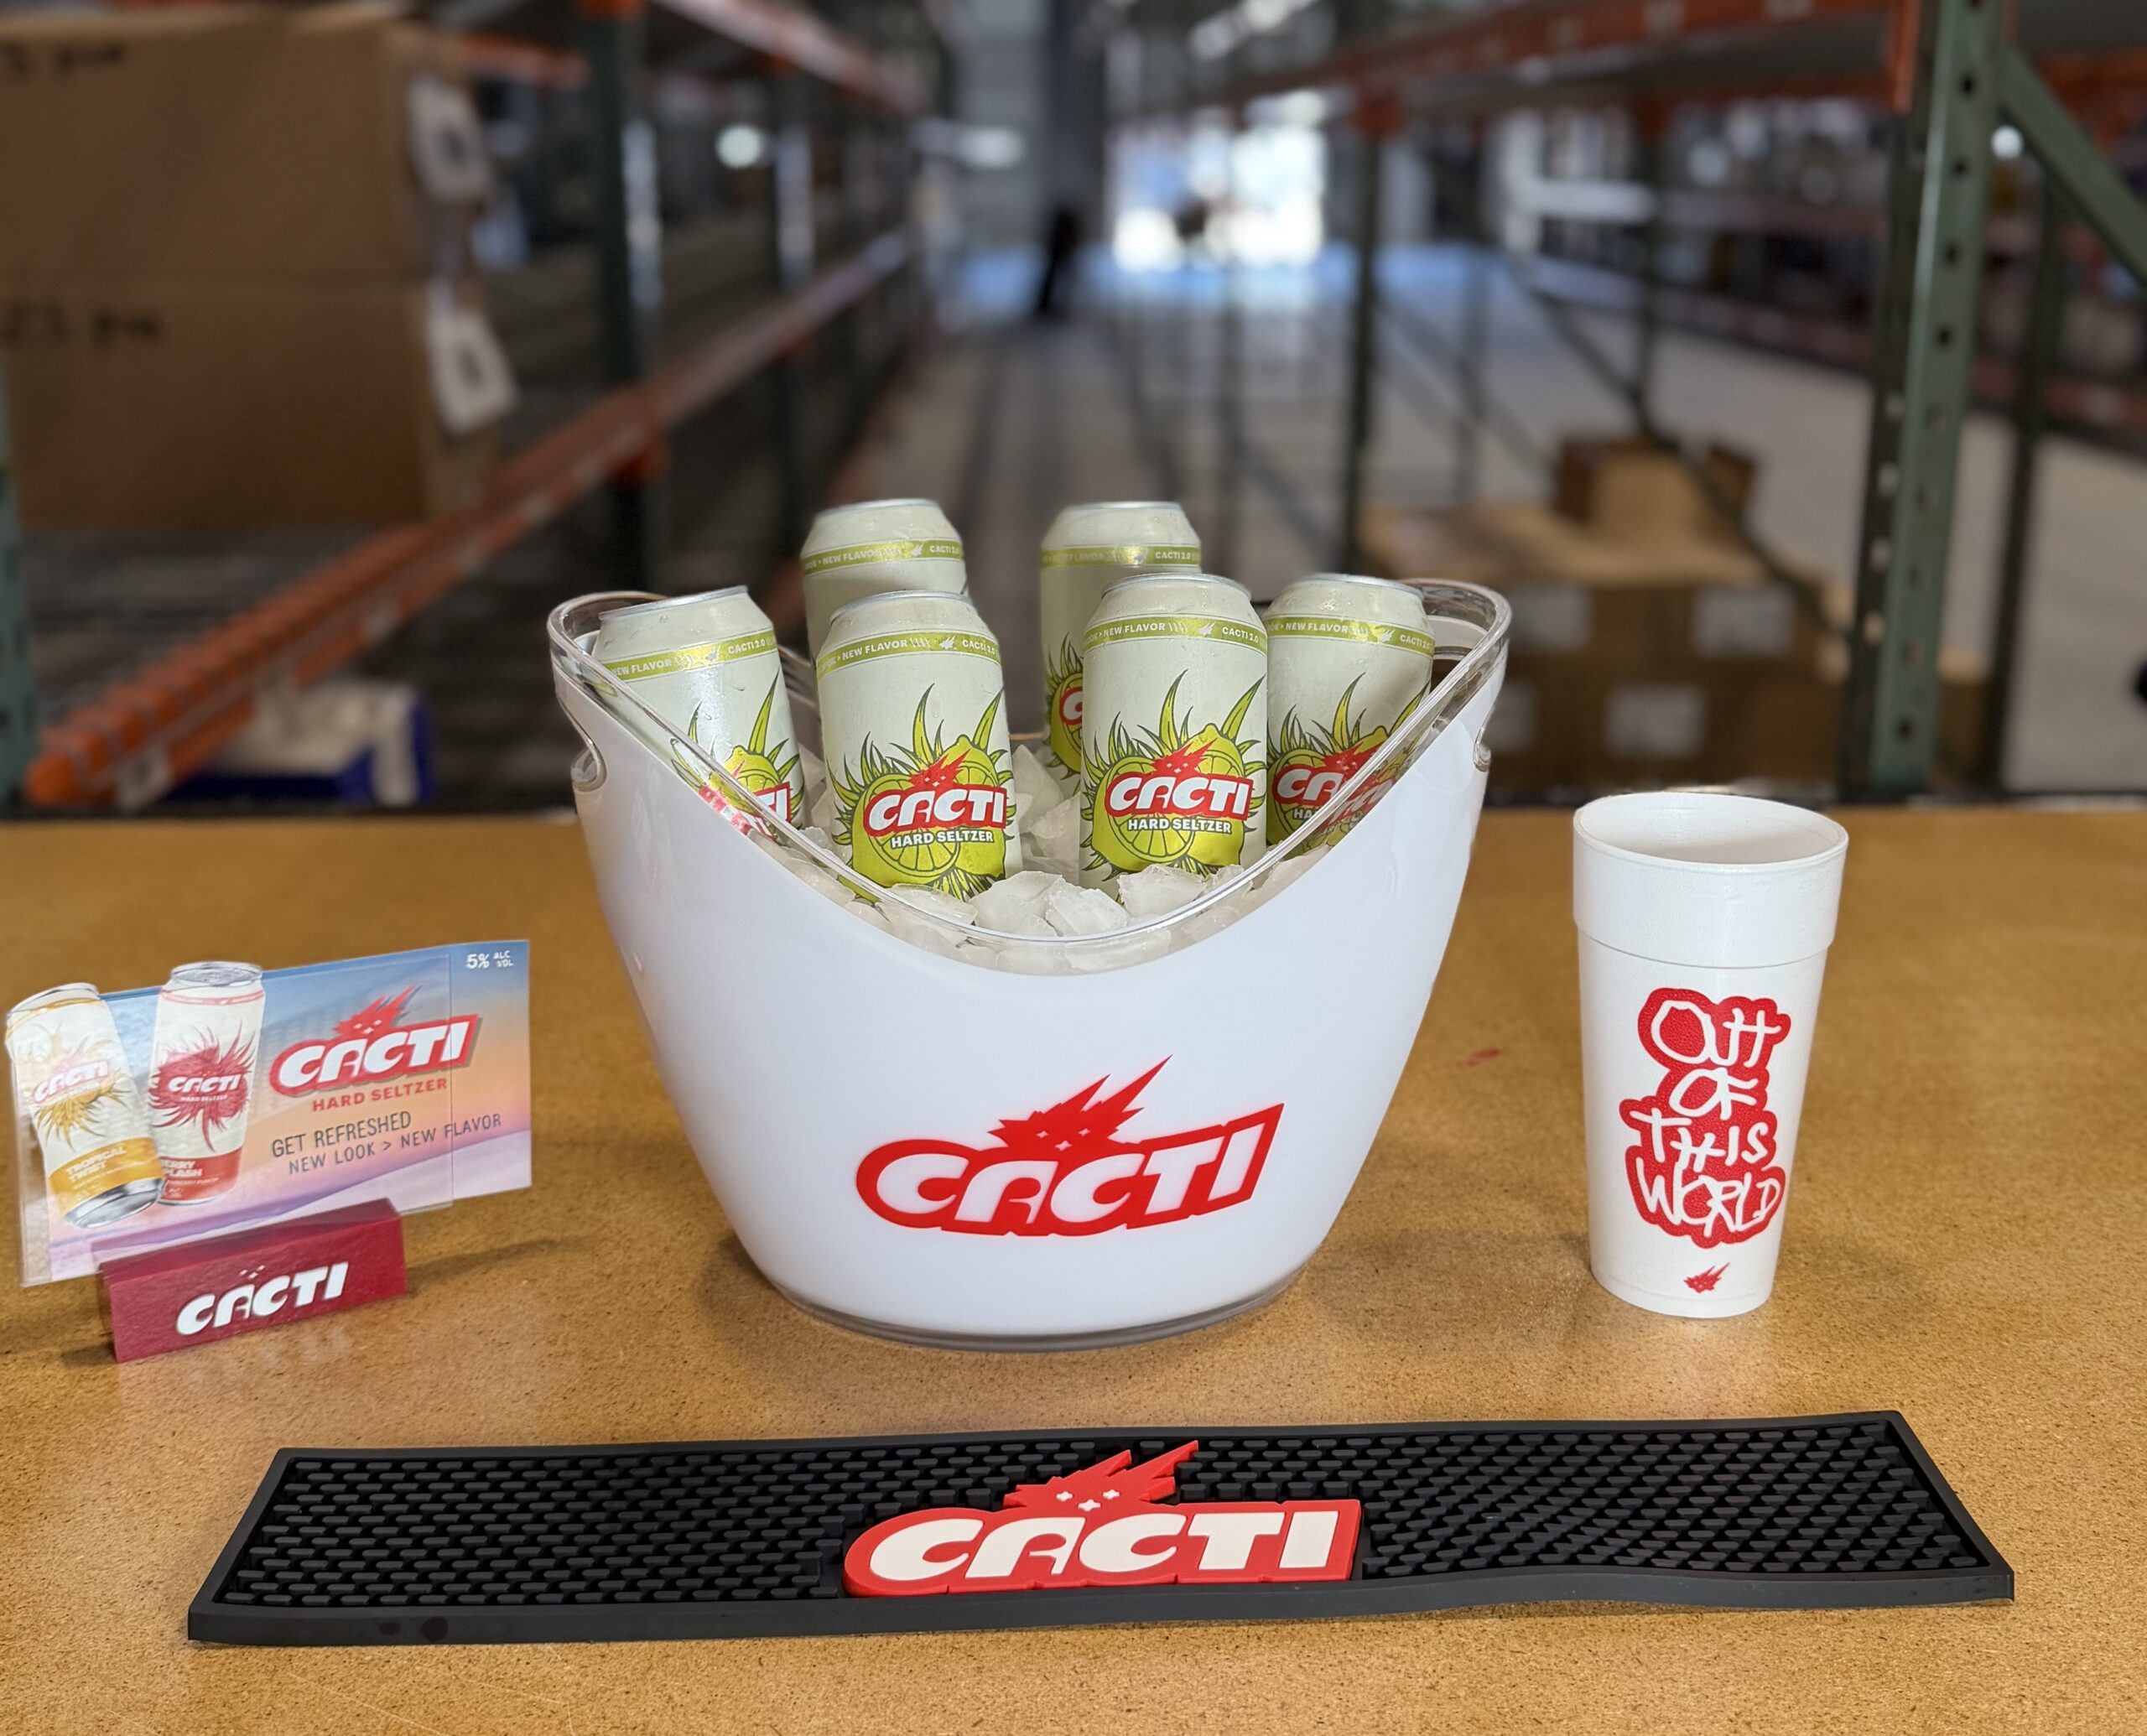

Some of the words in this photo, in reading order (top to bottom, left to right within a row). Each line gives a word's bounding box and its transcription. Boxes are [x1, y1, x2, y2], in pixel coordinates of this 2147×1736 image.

[1155, 551, 1181, 560] CACTI
[842, 647, 863, 660] NEW
[865, 638, 907, 654] FLAVOR
[962, 639, 986, 652] CACTI
[1103, 626, 1123, 637] NEW
[1125, 622, 1166, 633] FLAVOR
[1222, 626, 1248, 639] CACTI
[1285, 622, 1306, 631] NEW
[1307, 622, 1348, 633] FLAVOR
[1400, 634, 1422, 647] CACTI
[632, 658, 672, 673] FLAVOR
[728, 641, 755, 654] CACTI
[869, 788, 1005, 831] CACTI
[1109, 776, 1249, 815] CACTI
[891, 832, 933, 849] HARD
[936, 830, 994, 843] SELTZER
[1127, 818, 1169, 831] HARD
[1172, 818, 1232, 834] SELTZER
[465, 953, 490, 969] 5%
[493, 949, 511, 959] ALC
[1651, 999, 1781, 1068] OUT
[279, 1021, 470, 1088] CACTI
[169, 1073, 242, 1094] CACTI
[312, 1092, 365, 1112] HARD
[371, 1078, 448, 1102] SELTZER
[1669, 1067, 1759, 1120] OF
[272, 1133, 307, 1158] GET
[314, 1110, 411, 1149] REFRESHED
[289, 1153, 325, 1175] NEW
[335, 1141, 376, 1164] LOOK
[401, 1128, 437, 1149] NEW
[444, 1113, 502, 1137] FLAVOR
[1630, 1107, 1769, 1172] THIS
[876, 1121, 1266, 1225] CACTI
[1636, 1157, 1781, 1237] WORLD
[175, 1262, 349, 1336] CACTI
[869, 1510, 1340, 1582] CACTI
